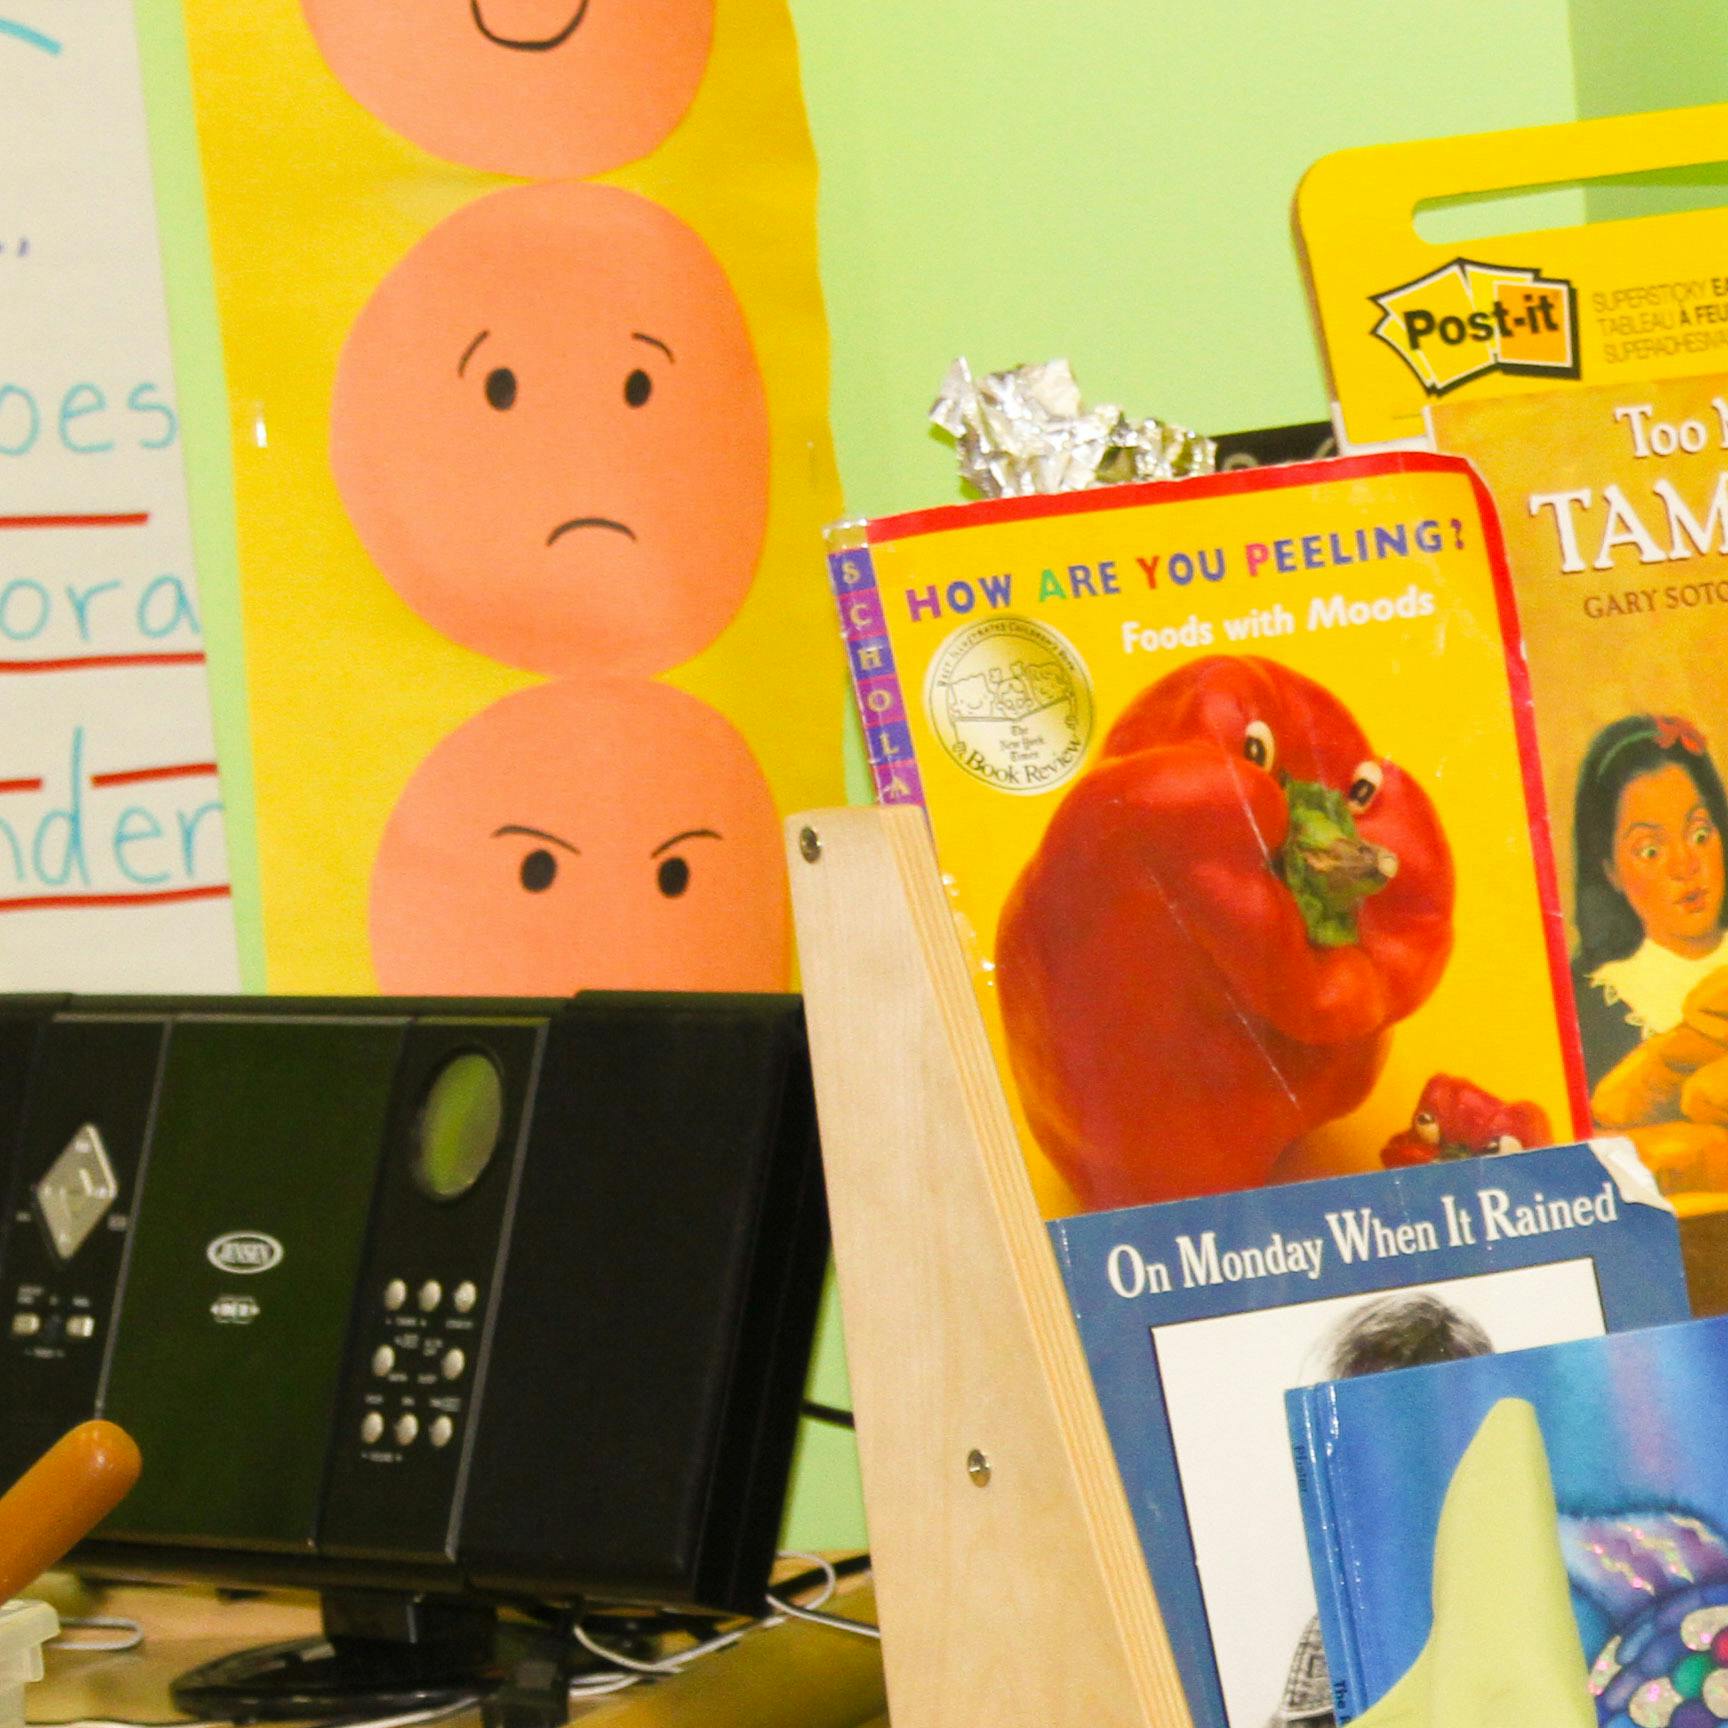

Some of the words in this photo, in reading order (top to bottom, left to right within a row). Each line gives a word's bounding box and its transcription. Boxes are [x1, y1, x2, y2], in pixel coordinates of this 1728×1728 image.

[1403, 293, 1558, 351] Post-it
[1614, 402, 1707, 459] Too
[905, 574, 1015, 625] HOW
[1037, 559, 1122, 603] ARE
[1137, 547, 1227, 591] YOU
[1245, 517, 1467, 578] PEELING?
[1120, 616, 1214, 654] Foods
[1221, 603, 1296, 647] with
[1306, 586, 1436, 633] Moods
[1584, 590, 1658, 619] GARY
[1107, 1245, 1173, 1302] On
[1178, 1228, 1324, 1290] Monday
[1325, 1207, 1440, 1263] When
[1442, 1194, 1478, 1249] It
[1479, 1181, 1620, 1240] Rained
